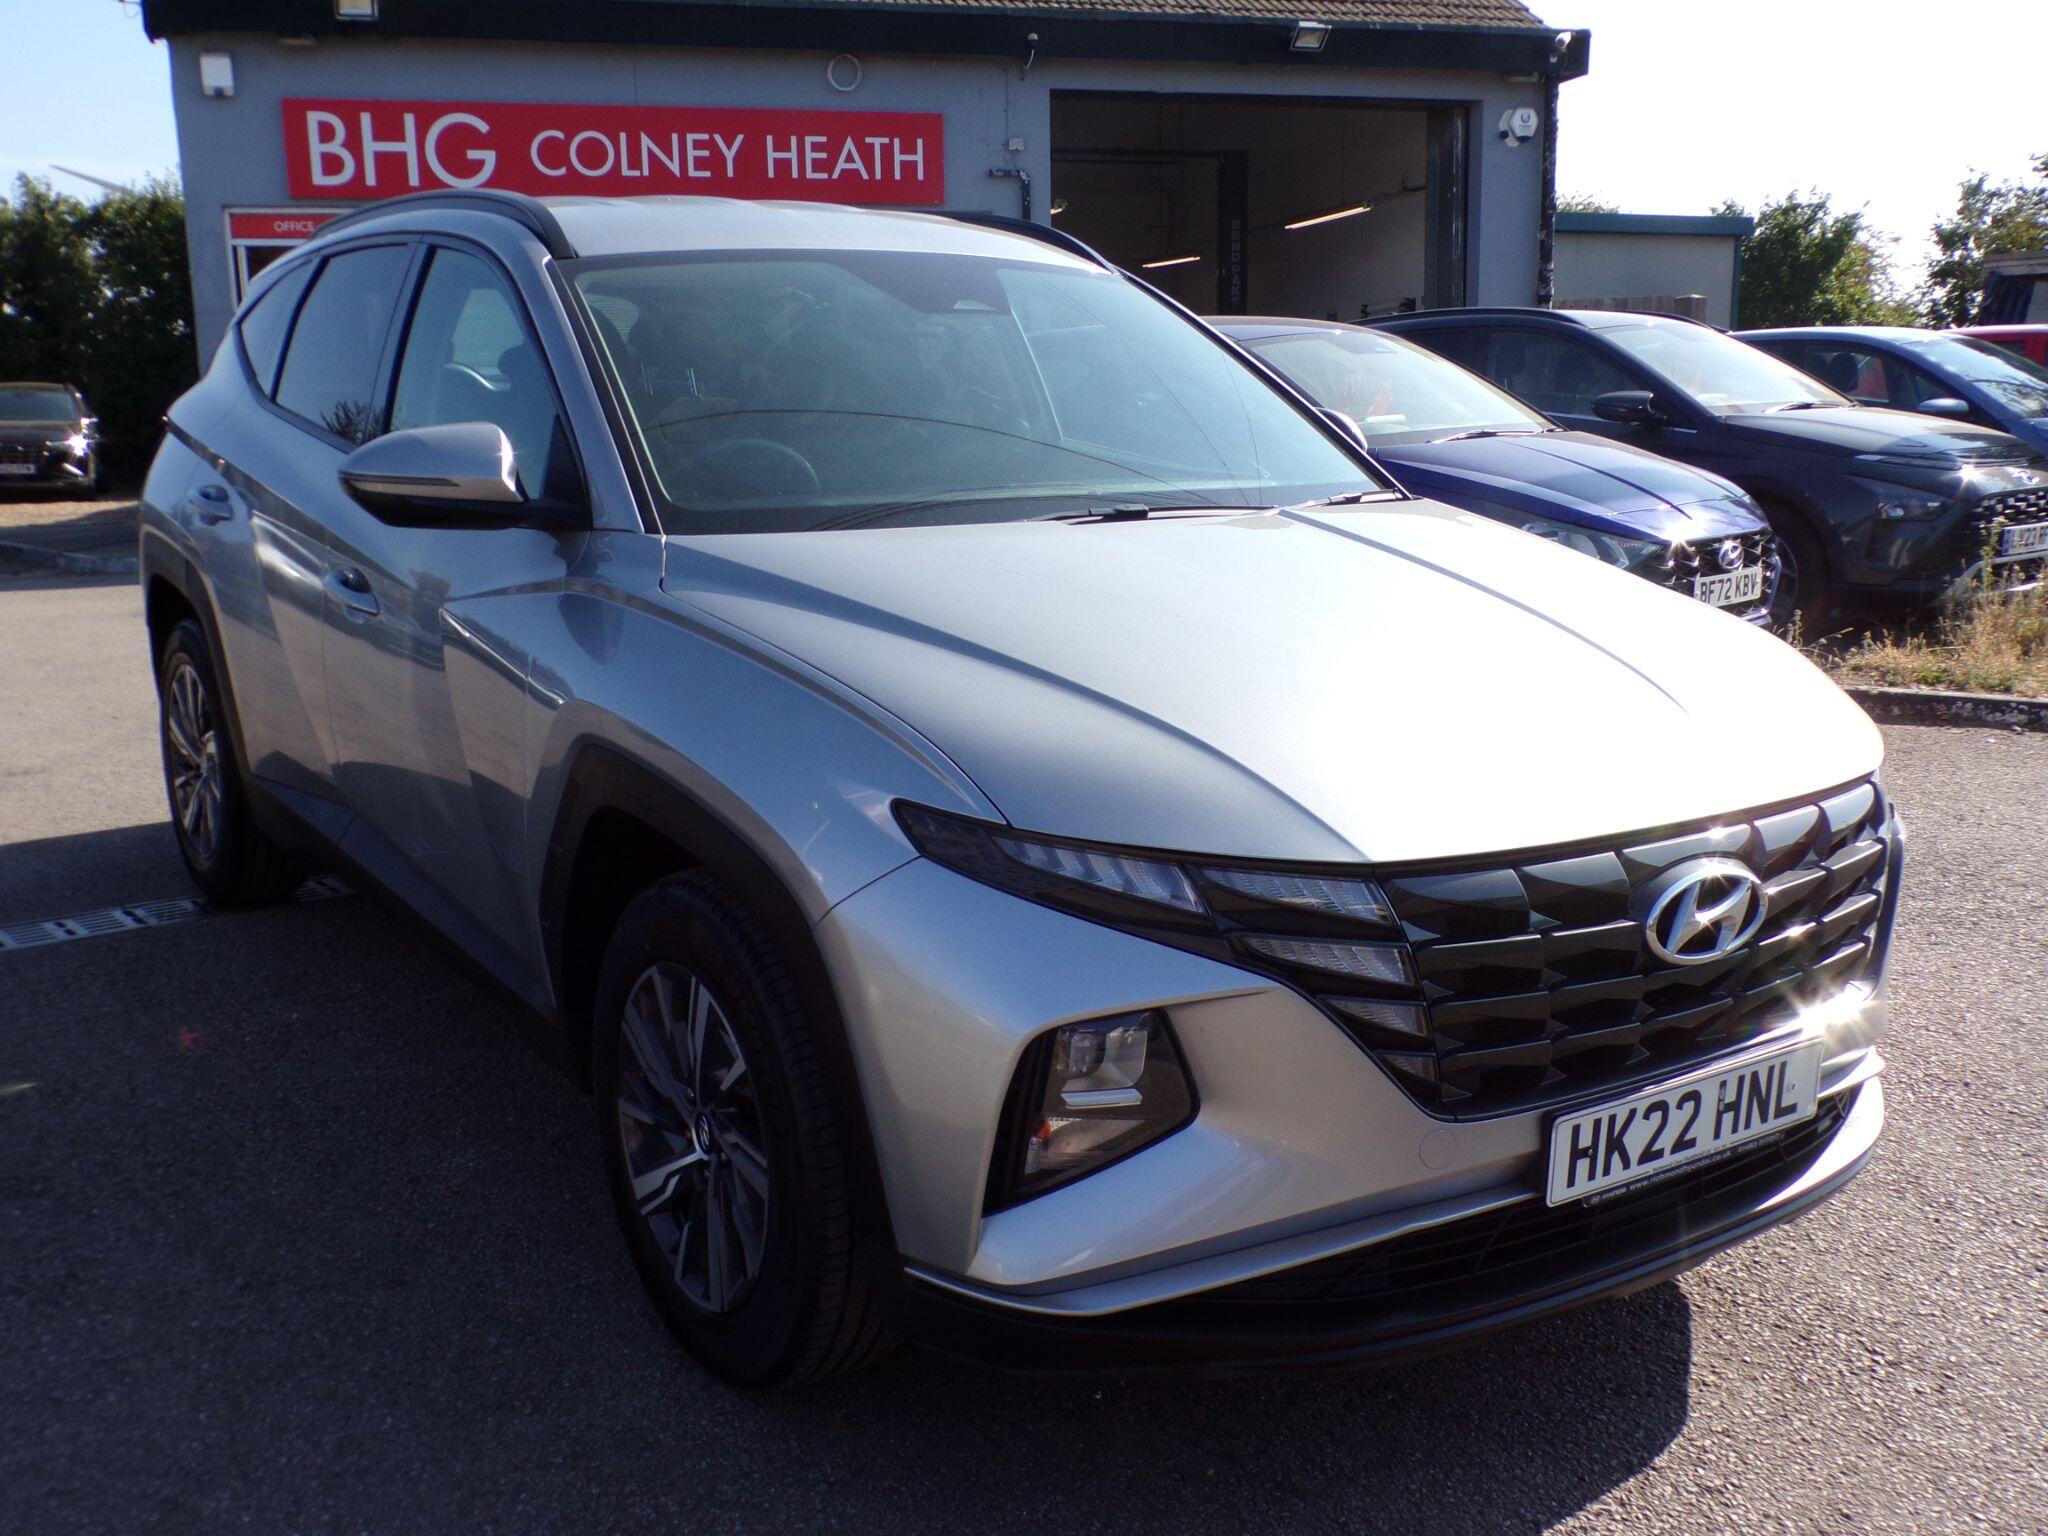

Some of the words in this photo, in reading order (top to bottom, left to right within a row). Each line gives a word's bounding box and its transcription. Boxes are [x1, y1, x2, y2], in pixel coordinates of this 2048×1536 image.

[306, 111, 496, 188] BHG
[530, 129, 744, 178] COLNEY
[766, 134, 925, 181] HEATH
[273, 220, 315, 232] OFFICE
[1699, 577, 1733, 603] BF72
[1566, 1089, 1702, 1189] HK22
[1713, 1060, 1798, 1141] HNL
